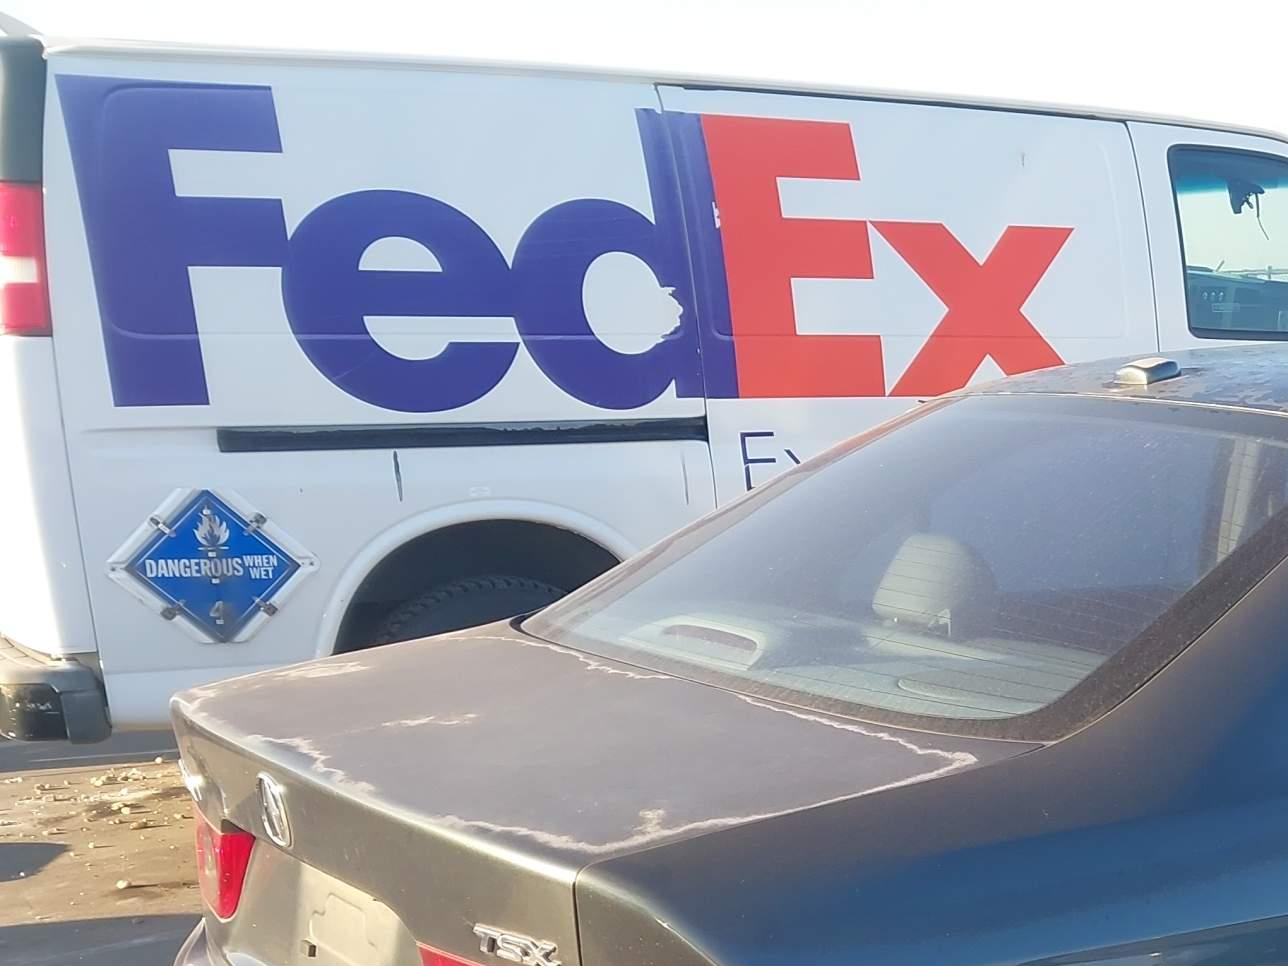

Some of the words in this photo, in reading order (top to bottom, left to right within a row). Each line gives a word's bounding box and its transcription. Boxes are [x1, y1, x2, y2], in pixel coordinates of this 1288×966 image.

[56, 74, 1074, 413] FedEx
[145, 558, 244, 578] DANGEROUS
[244, 555, 278, 567] WHEN
[249, 567, 274, 580] WET
[209, 600, 224, 620] 4
